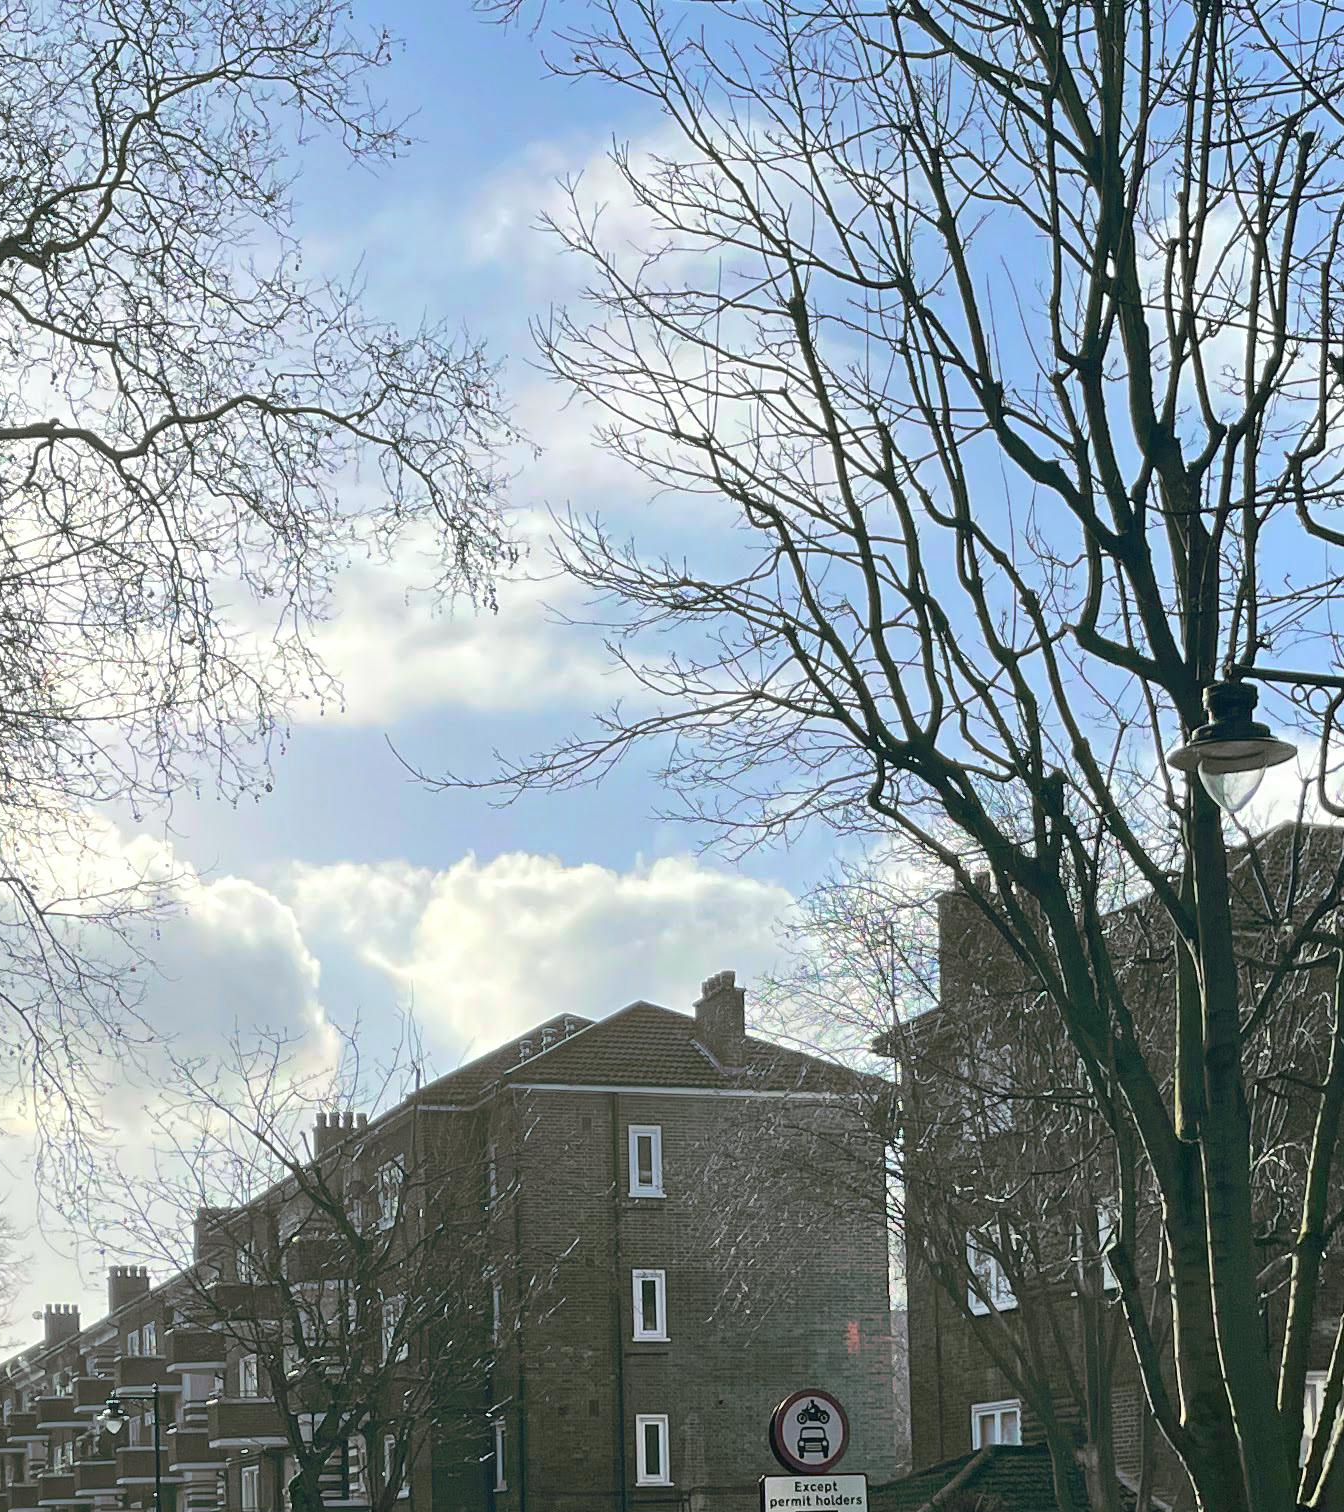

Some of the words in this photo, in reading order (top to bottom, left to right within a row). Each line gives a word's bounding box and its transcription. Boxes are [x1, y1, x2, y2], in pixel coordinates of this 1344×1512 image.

[794, 1481, 838, 1493] Except
[769, 1496, 811, 1509] permit
[816, 1494, 862, 1506] holders
